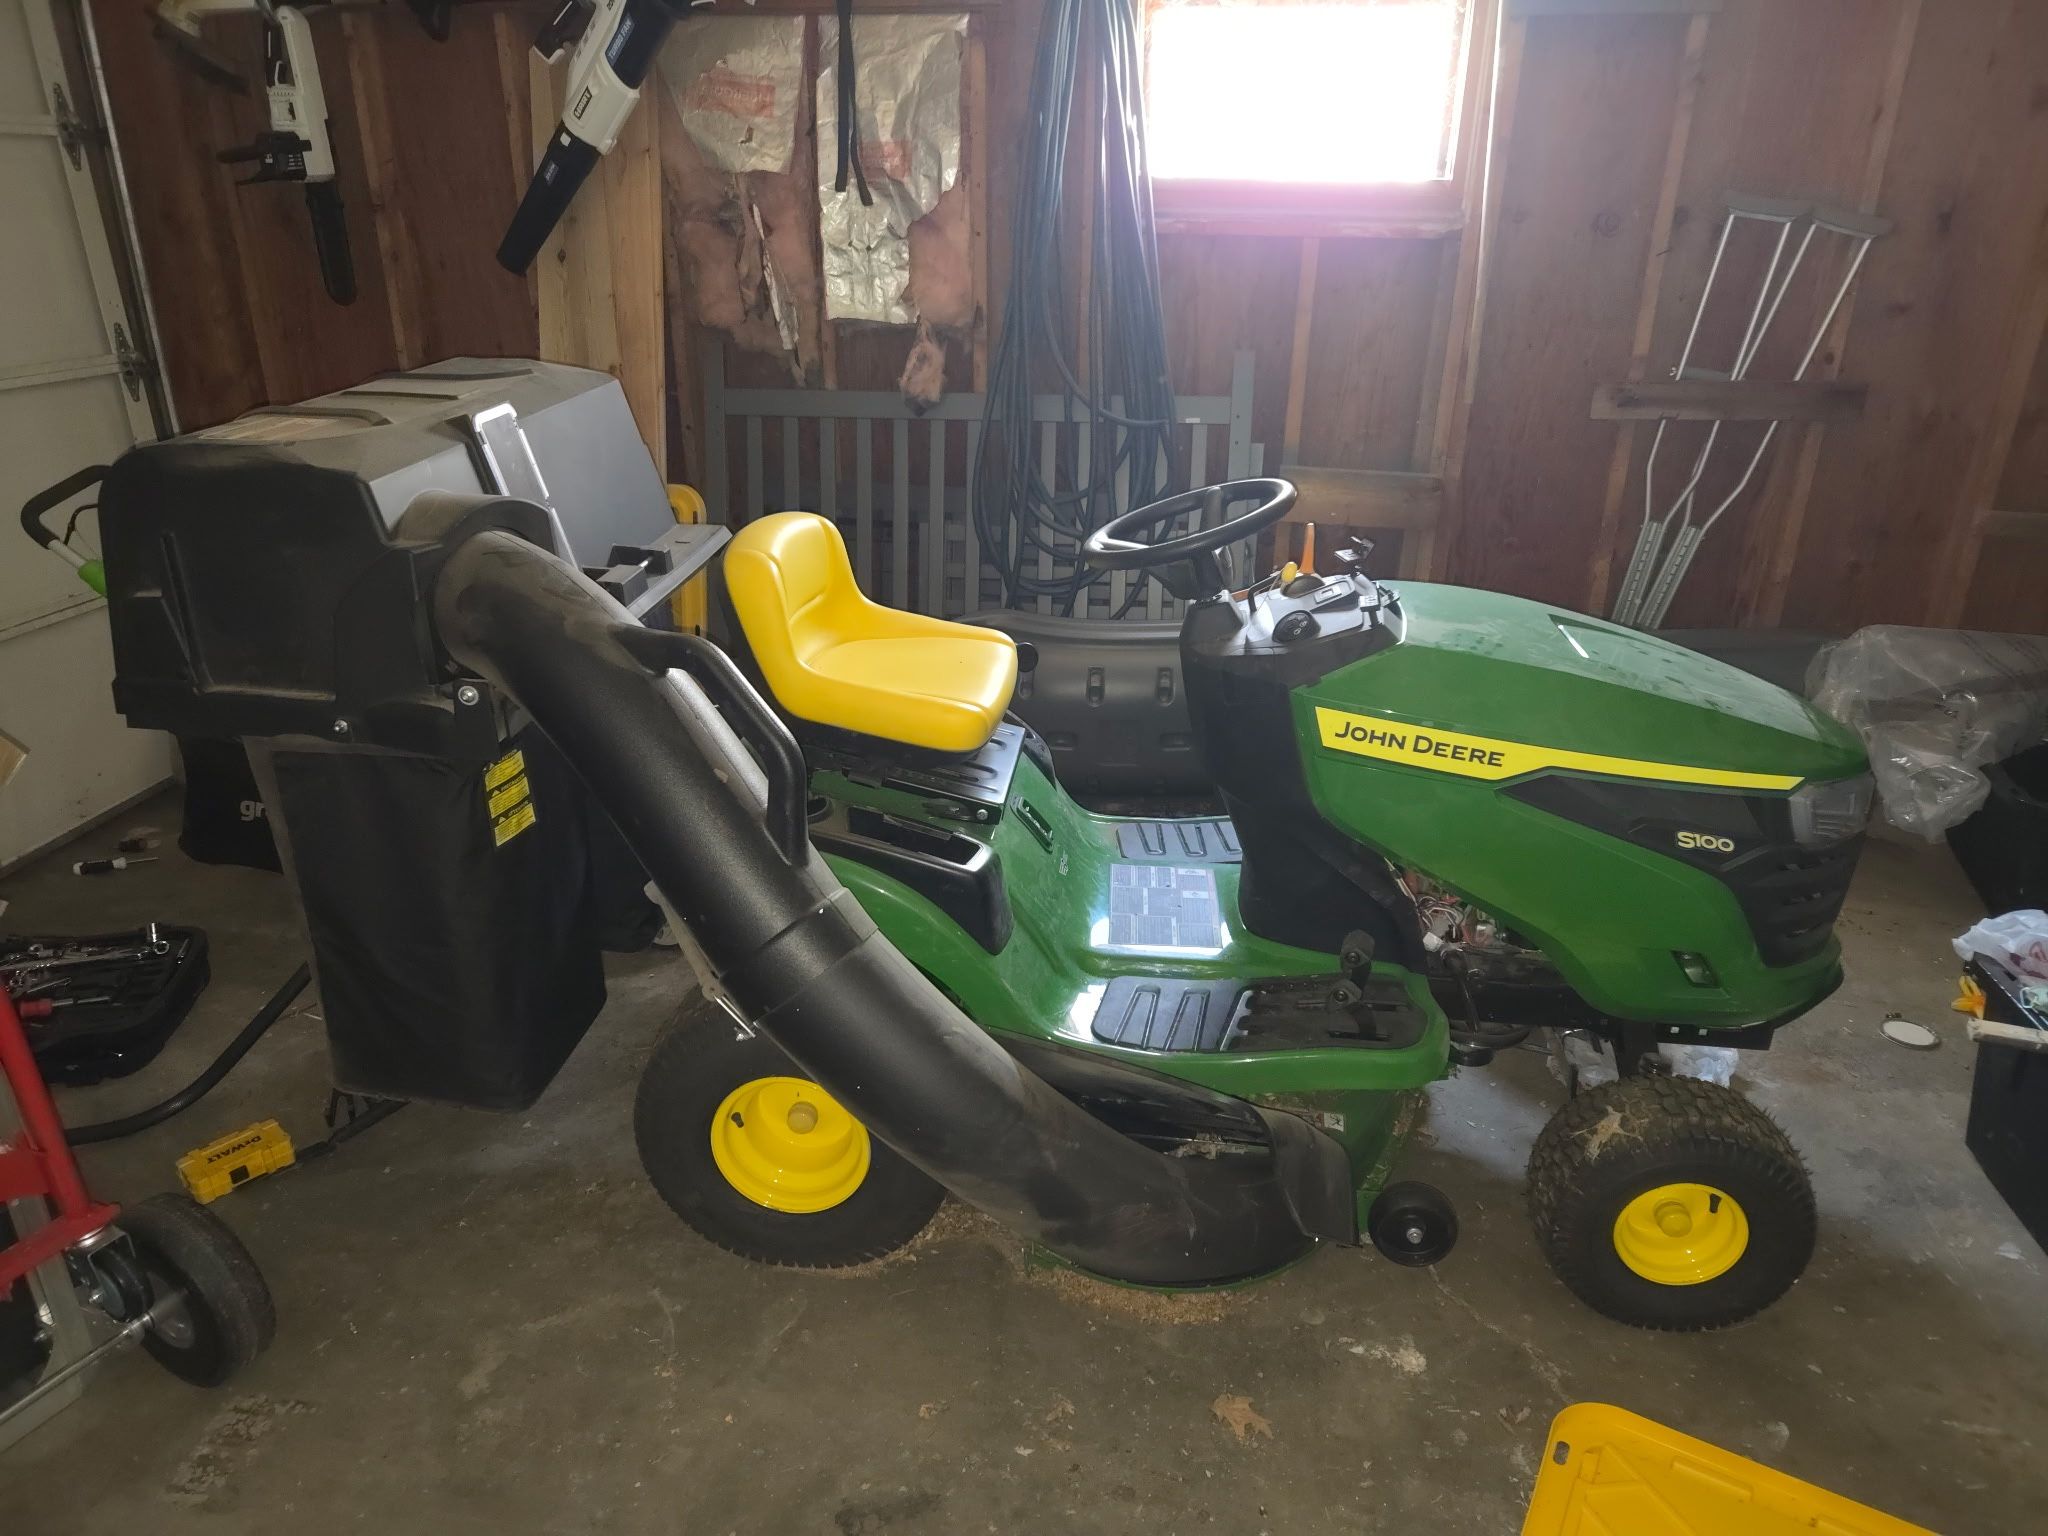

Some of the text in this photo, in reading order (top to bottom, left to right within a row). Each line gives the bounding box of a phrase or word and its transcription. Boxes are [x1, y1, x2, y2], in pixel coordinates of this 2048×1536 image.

[607, 33, 624, 59] TURBO
[1335, 721, 1505, 767] JOHN DEERE
[1677, 831, 1735, 852] S100
